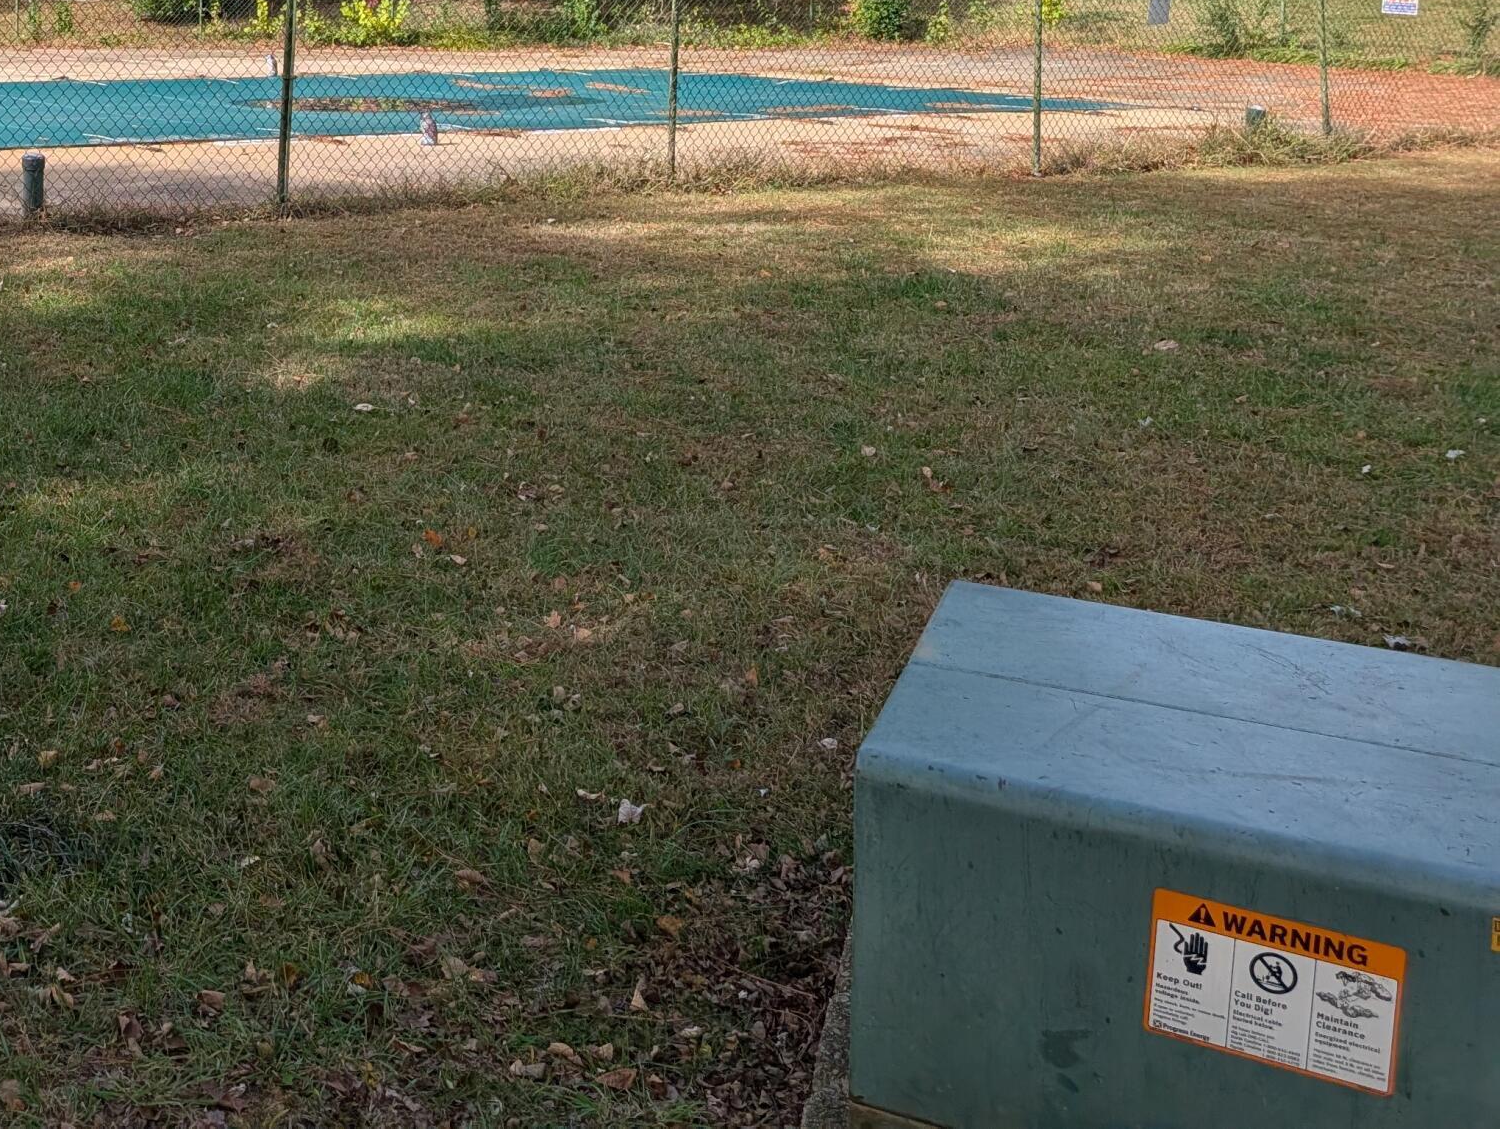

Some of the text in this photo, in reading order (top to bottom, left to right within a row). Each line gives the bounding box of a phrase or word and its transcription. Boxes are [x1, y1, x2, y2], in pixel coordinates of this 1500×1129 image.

[1222, 910, 1368, 966] WARNING
[1156, 971, 1203, 990] Keep Out!
[1234, 989, 1288, 1010] Call Before
[1234, 998, 1273, 1016] You Dig!
[1315, 1020, 1366, 1040] Clearance
[1316, 1011, 1359, 1029] Maintain
[1315, 1031, 1381, 1054] Energized electrical
